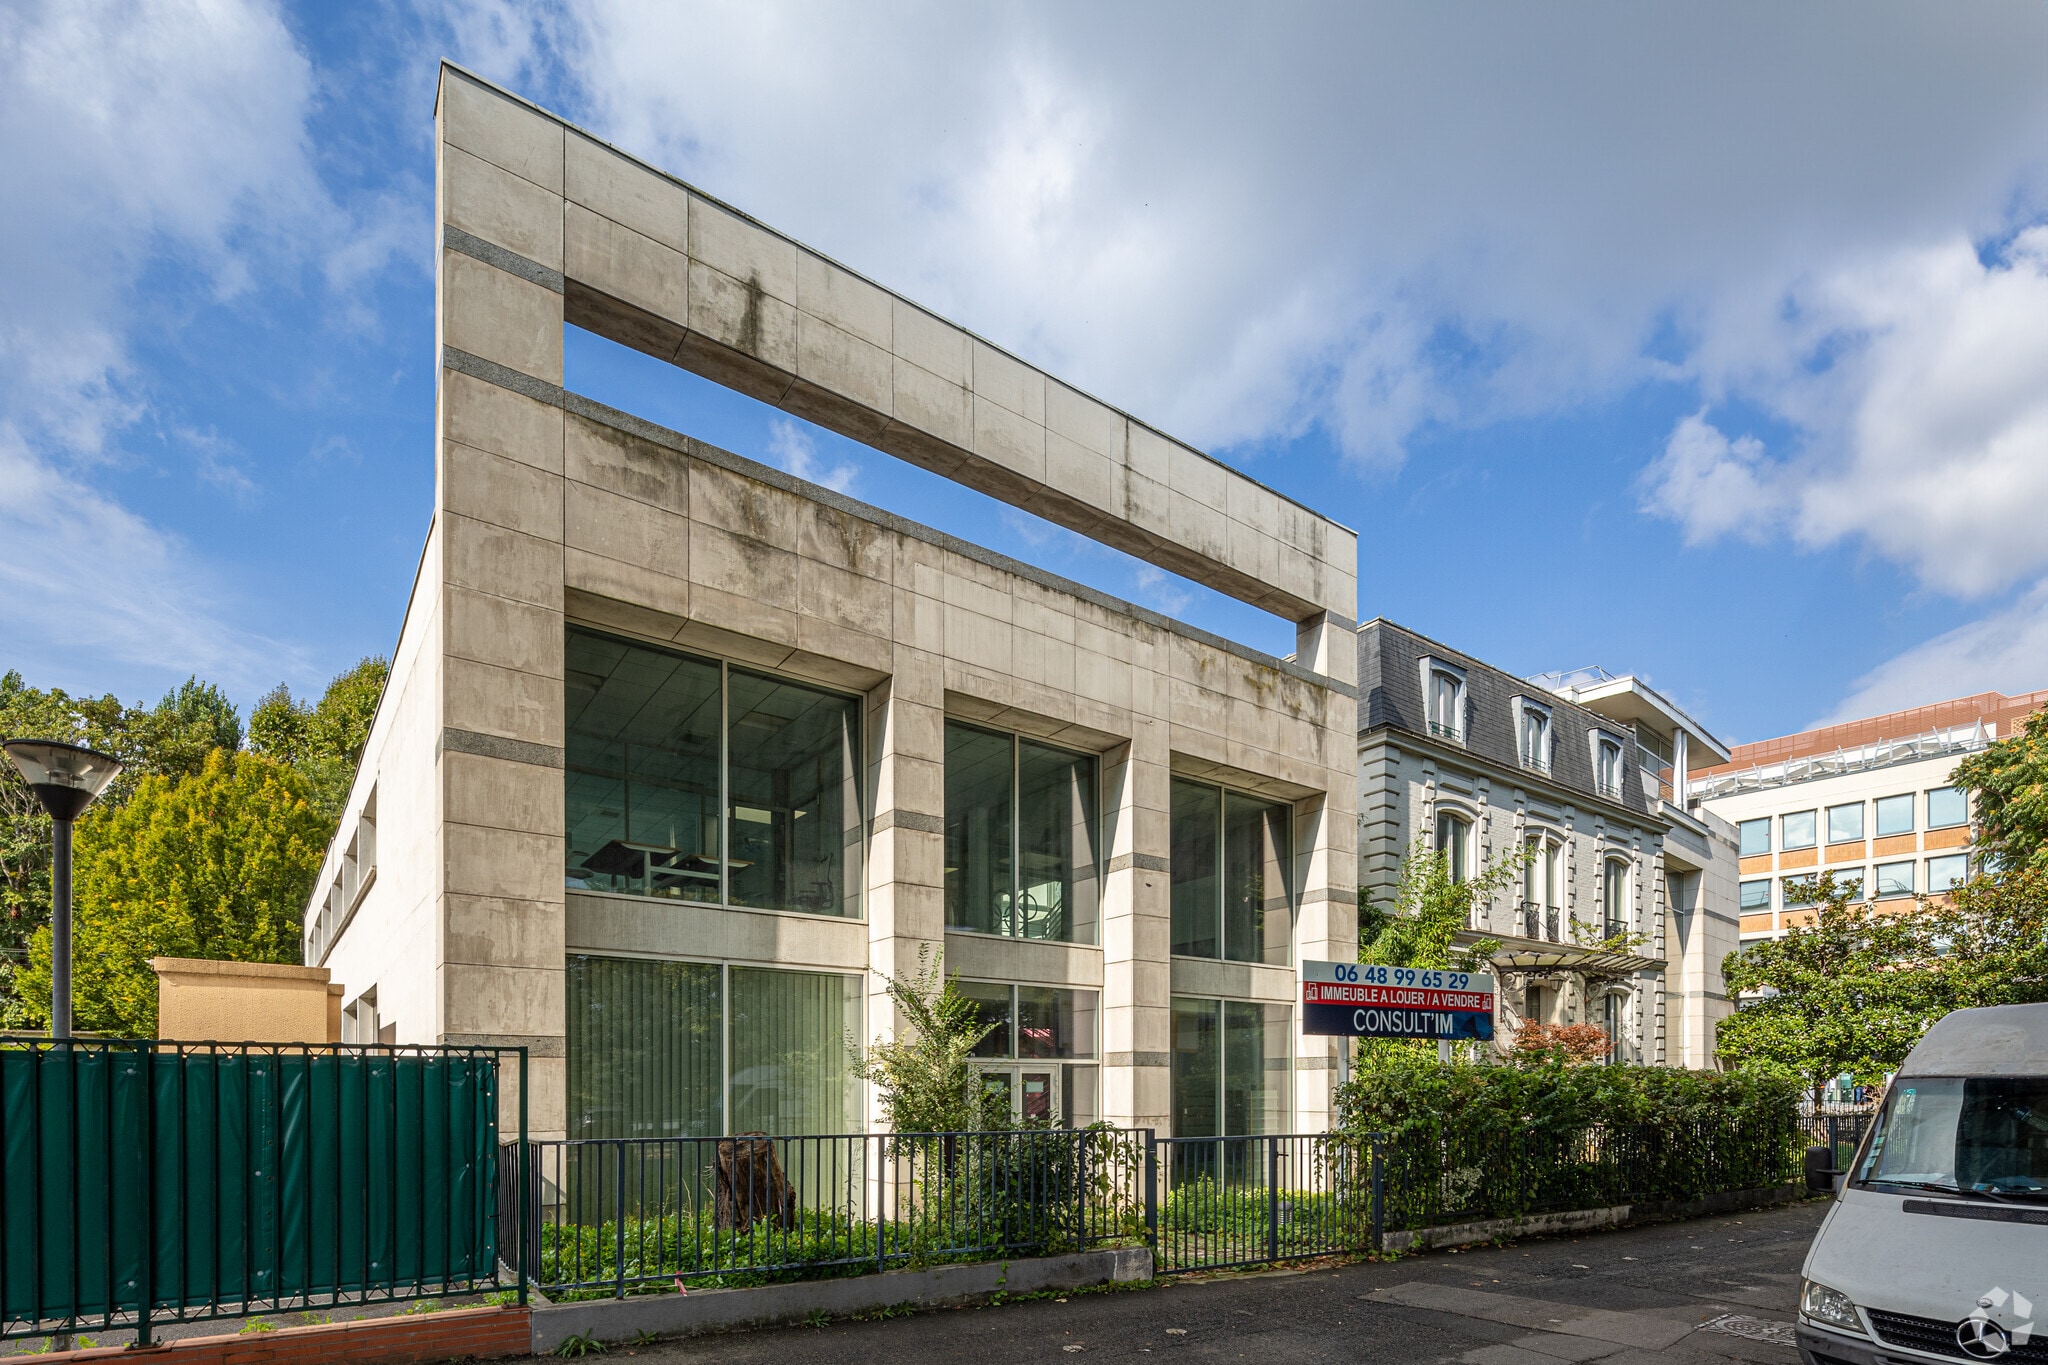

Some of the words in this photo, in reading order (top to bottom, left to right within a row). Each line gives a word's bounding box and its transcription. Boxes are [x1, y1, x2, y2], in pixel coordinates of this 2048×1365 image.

[1334, 964, 1358, 982] 06
[1365, 966, 1388, 985] 48
[1394, 968, 1416, 986] 99
[1421, 971, 1443, 988] 65
[1448, 973, 1469, 990] 29
[1320, 985, 1378, 1003] IMMEUBLE
[1380, 989, 1389, 1003] A
[1390, 990, 1425, 1005] LOUER
[1433, 993, 1442, 1006] A
[1442, 994, 1480, 1008] VENDRE
